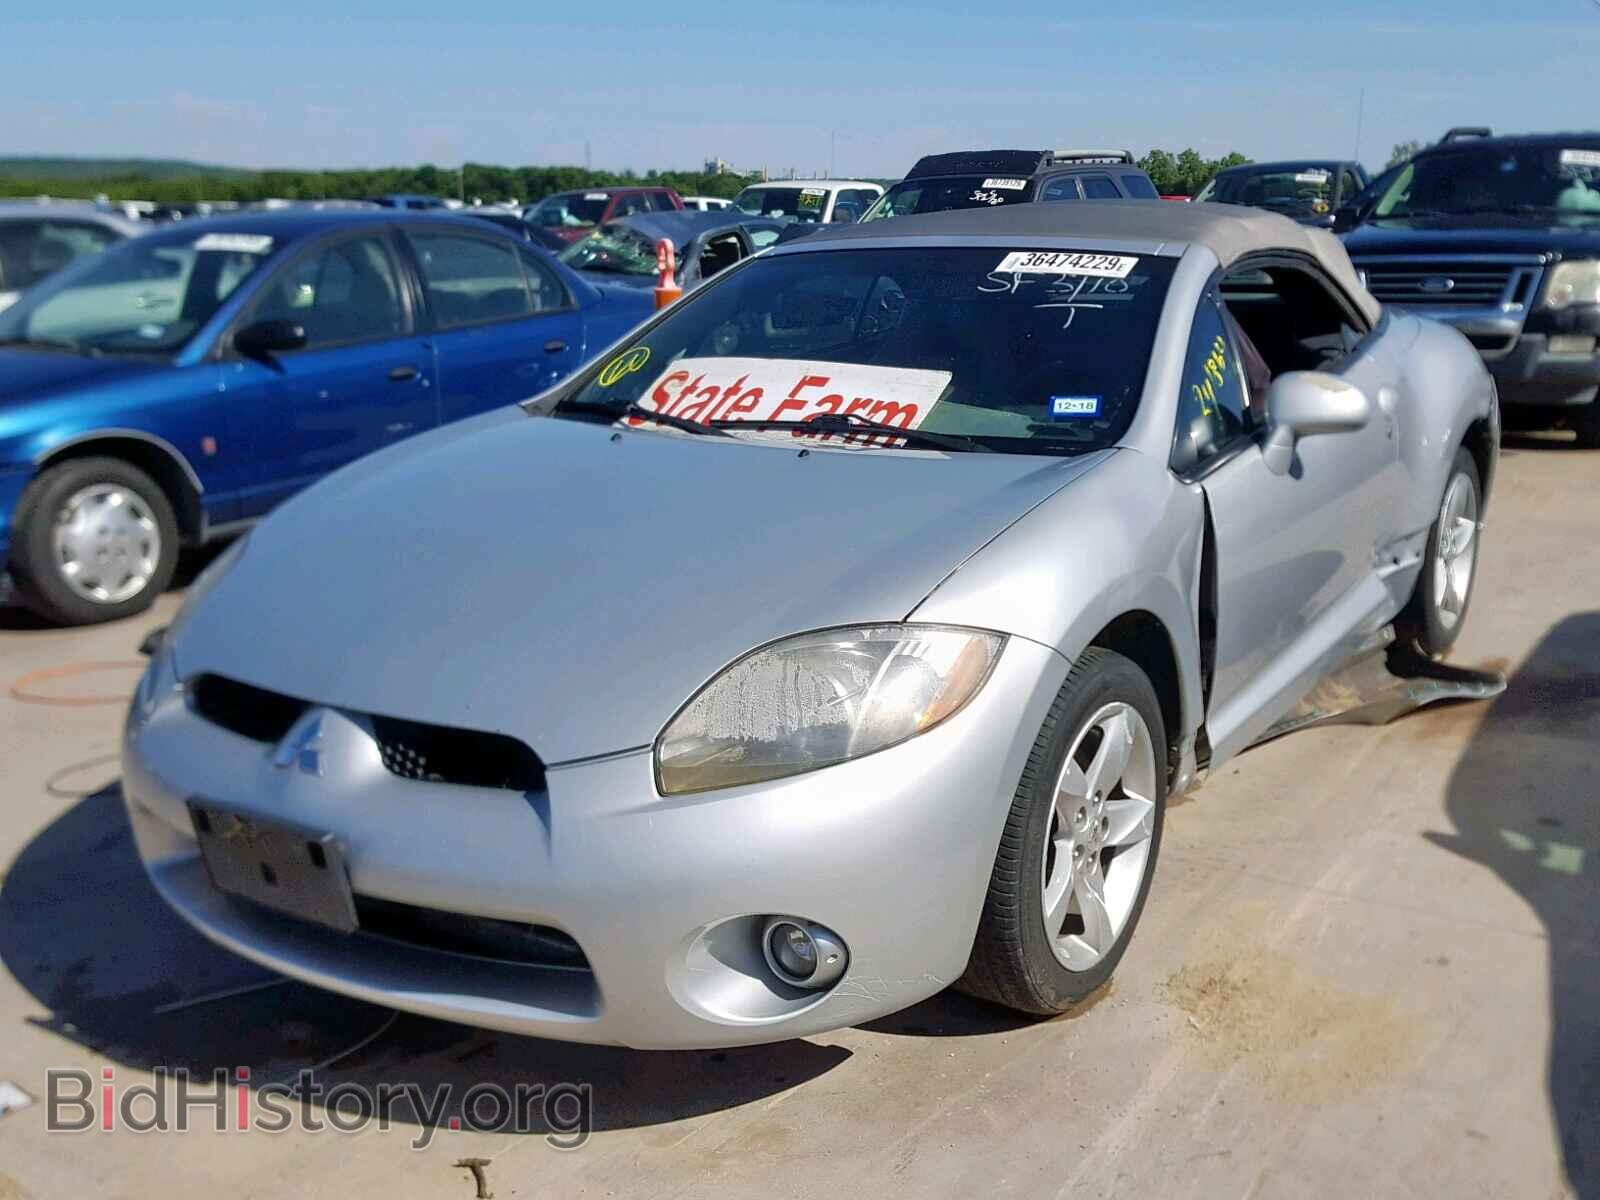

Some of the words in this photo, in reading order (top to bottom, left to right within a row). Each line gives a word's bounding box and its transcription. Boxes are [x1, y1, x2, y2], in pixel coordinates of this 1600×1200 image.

[1019, 253, 1121, 271] 36474229
[629, 370, 764, 427] State
[755, 375, 919, 448] Farm
